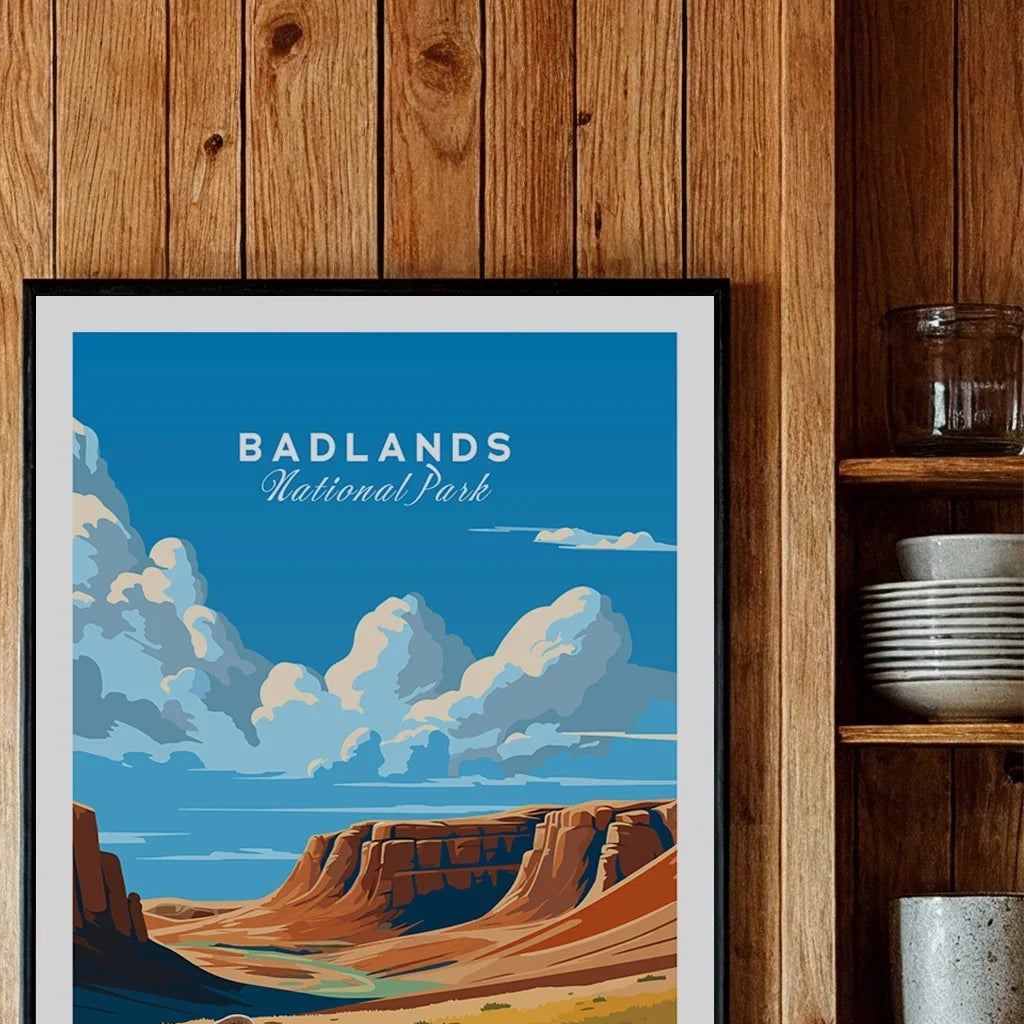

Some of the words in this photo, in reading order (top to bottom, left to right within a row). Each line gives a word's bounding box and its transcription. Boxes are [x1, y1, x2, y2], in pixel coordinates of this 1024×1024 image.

[239, 432, 511, 463] BADLANDS
[261, 468, 414, 503] National
[403, 463, 492, 506] Park
